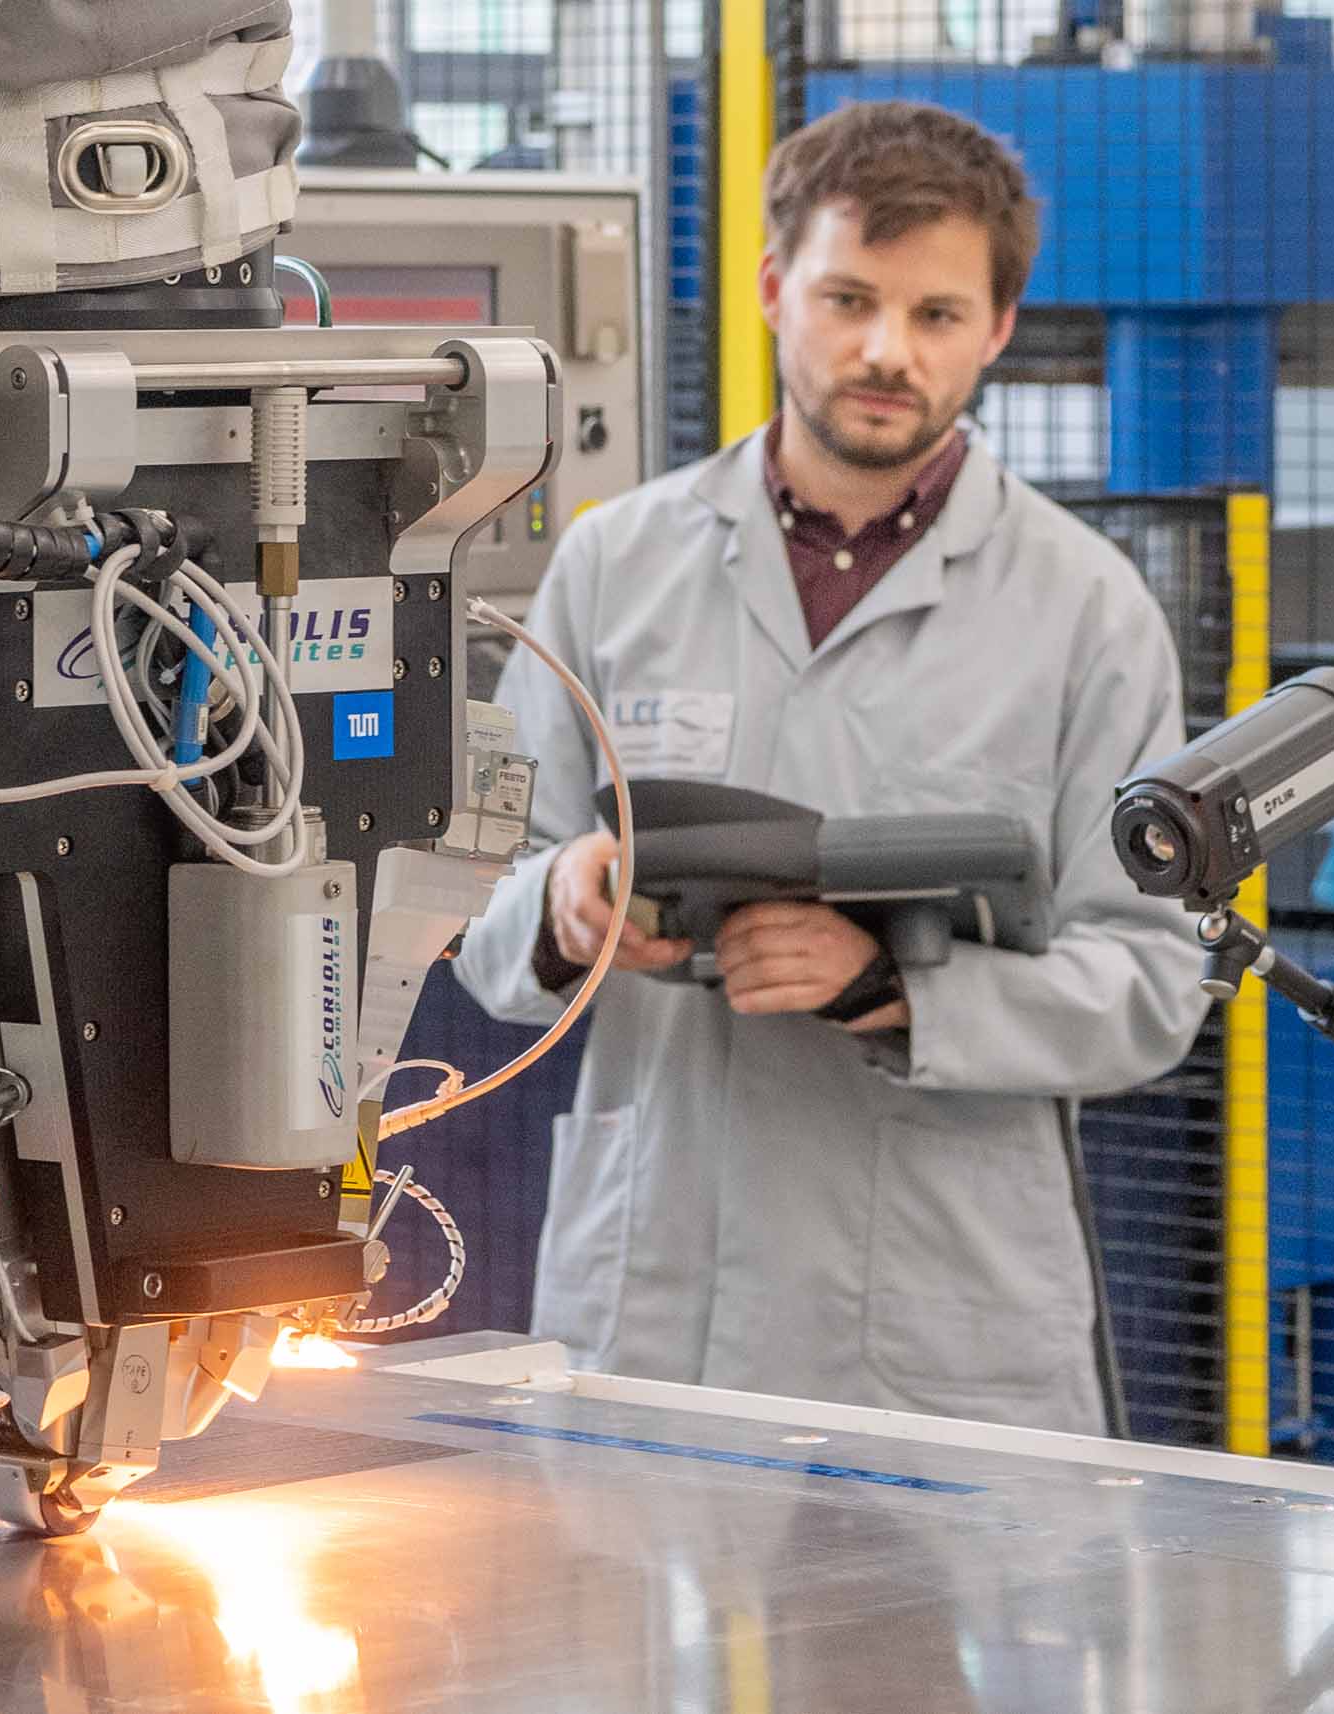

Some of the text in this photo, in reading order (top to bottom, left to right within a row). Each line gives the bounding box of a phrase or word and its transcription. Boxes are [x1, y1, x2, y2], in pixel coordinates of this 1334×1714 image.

[348, 713, 379, 737] TUM
[1272, 787, 1295, 809] FLIR
[323, 917, 335, 1050] CORIOLIS
